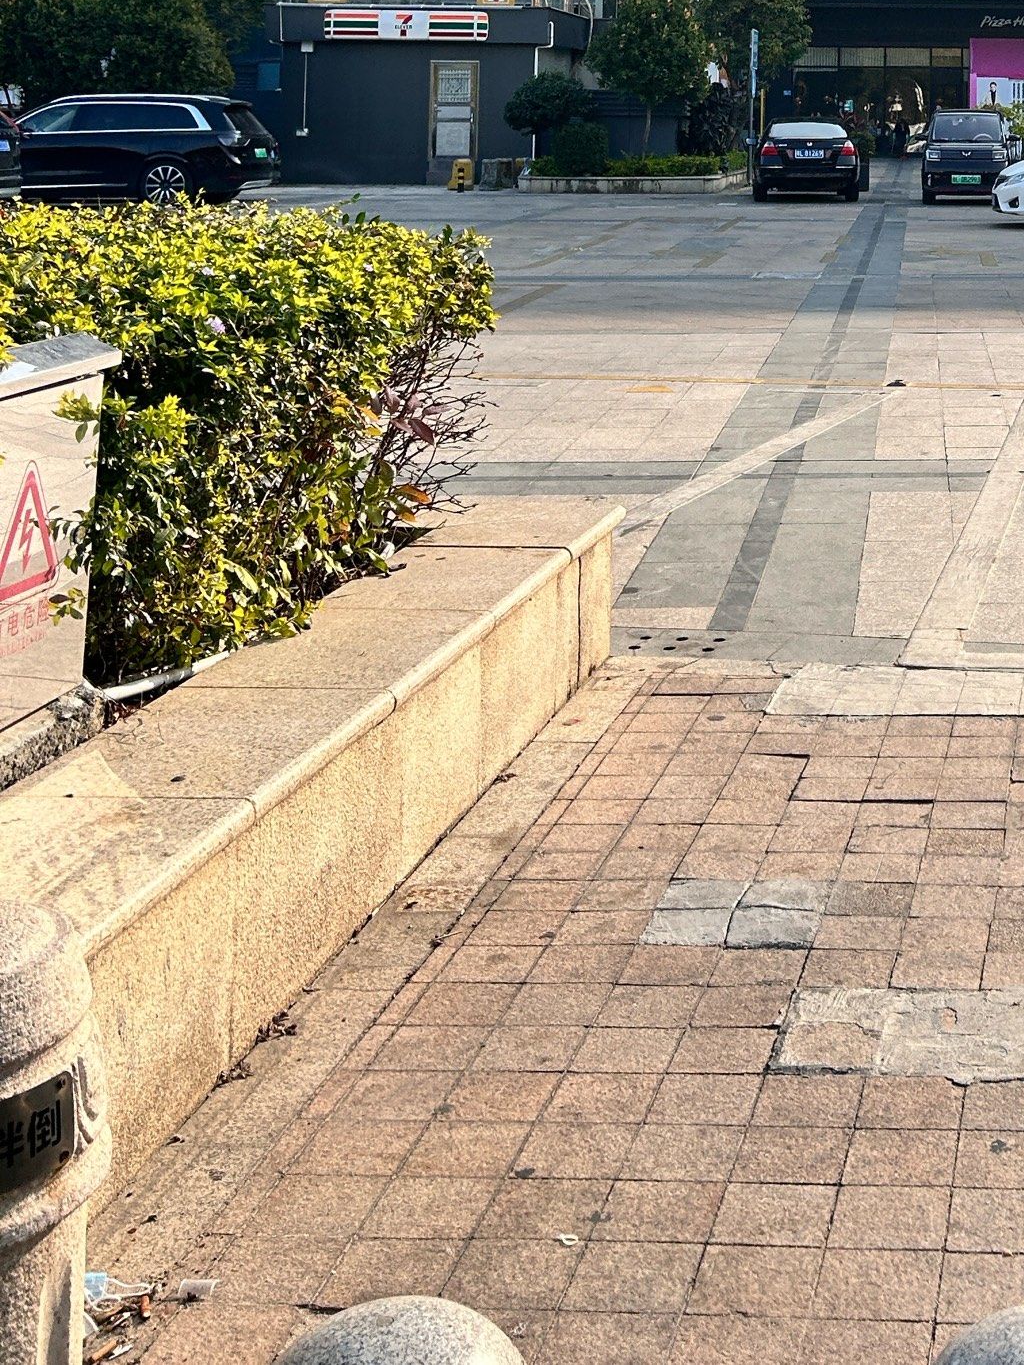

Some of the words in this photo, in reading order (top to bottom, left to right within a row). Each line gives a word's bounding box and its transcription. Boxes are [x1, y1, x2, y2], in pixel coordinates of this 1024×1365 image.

[980, 15, 1011, 28] Pizza
[0, 597, 50, 637] 电危险
